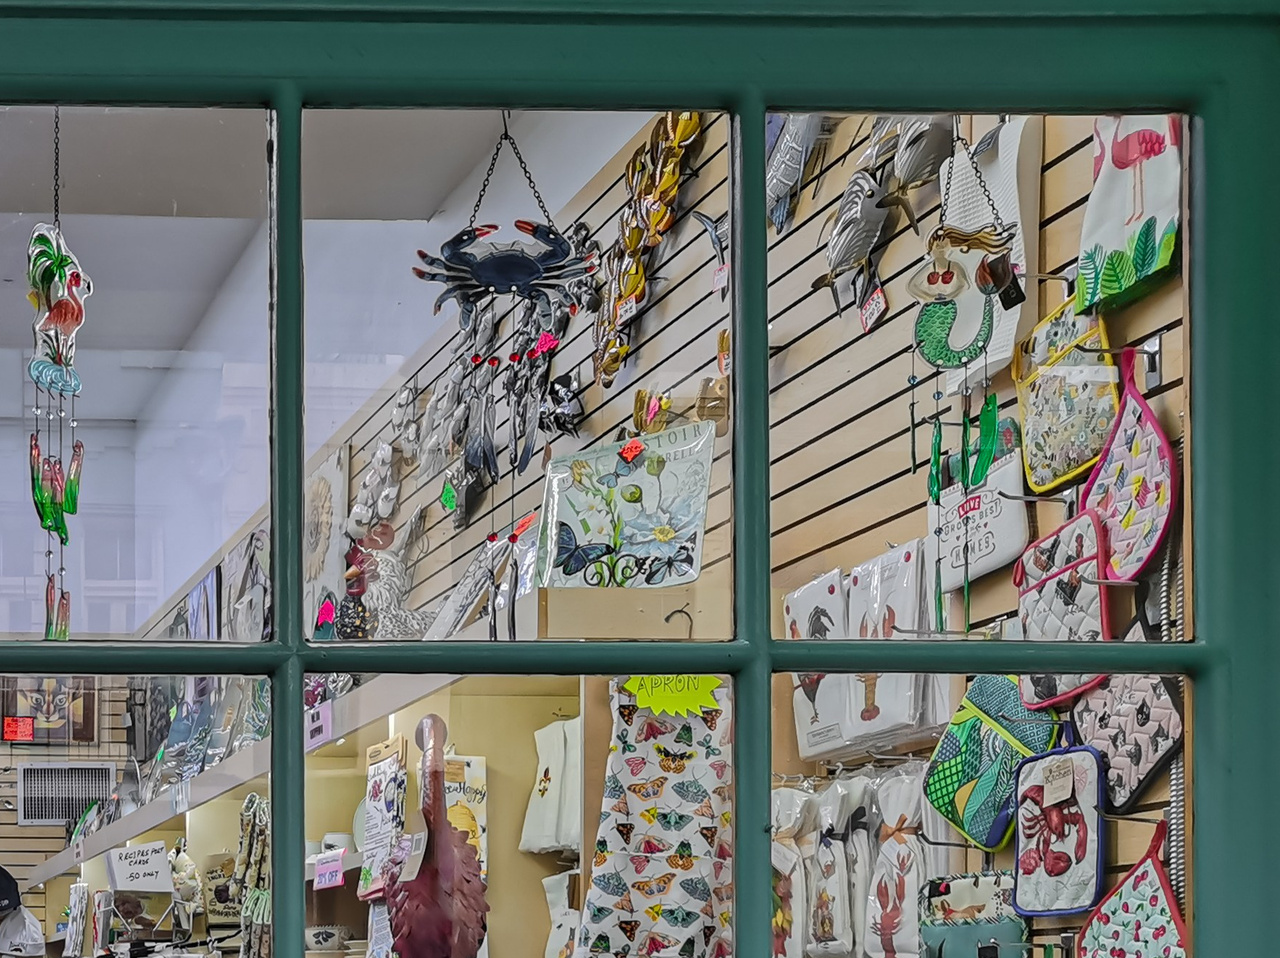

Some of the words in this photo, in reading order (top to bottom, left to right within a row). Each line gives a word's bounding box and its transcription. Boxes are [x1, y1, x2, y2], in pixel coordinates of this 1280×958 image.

[637, 675, 700, 697] APRON
[142, 871, 159, 881] ONLY
[328, 870, 338, 882] OFF
